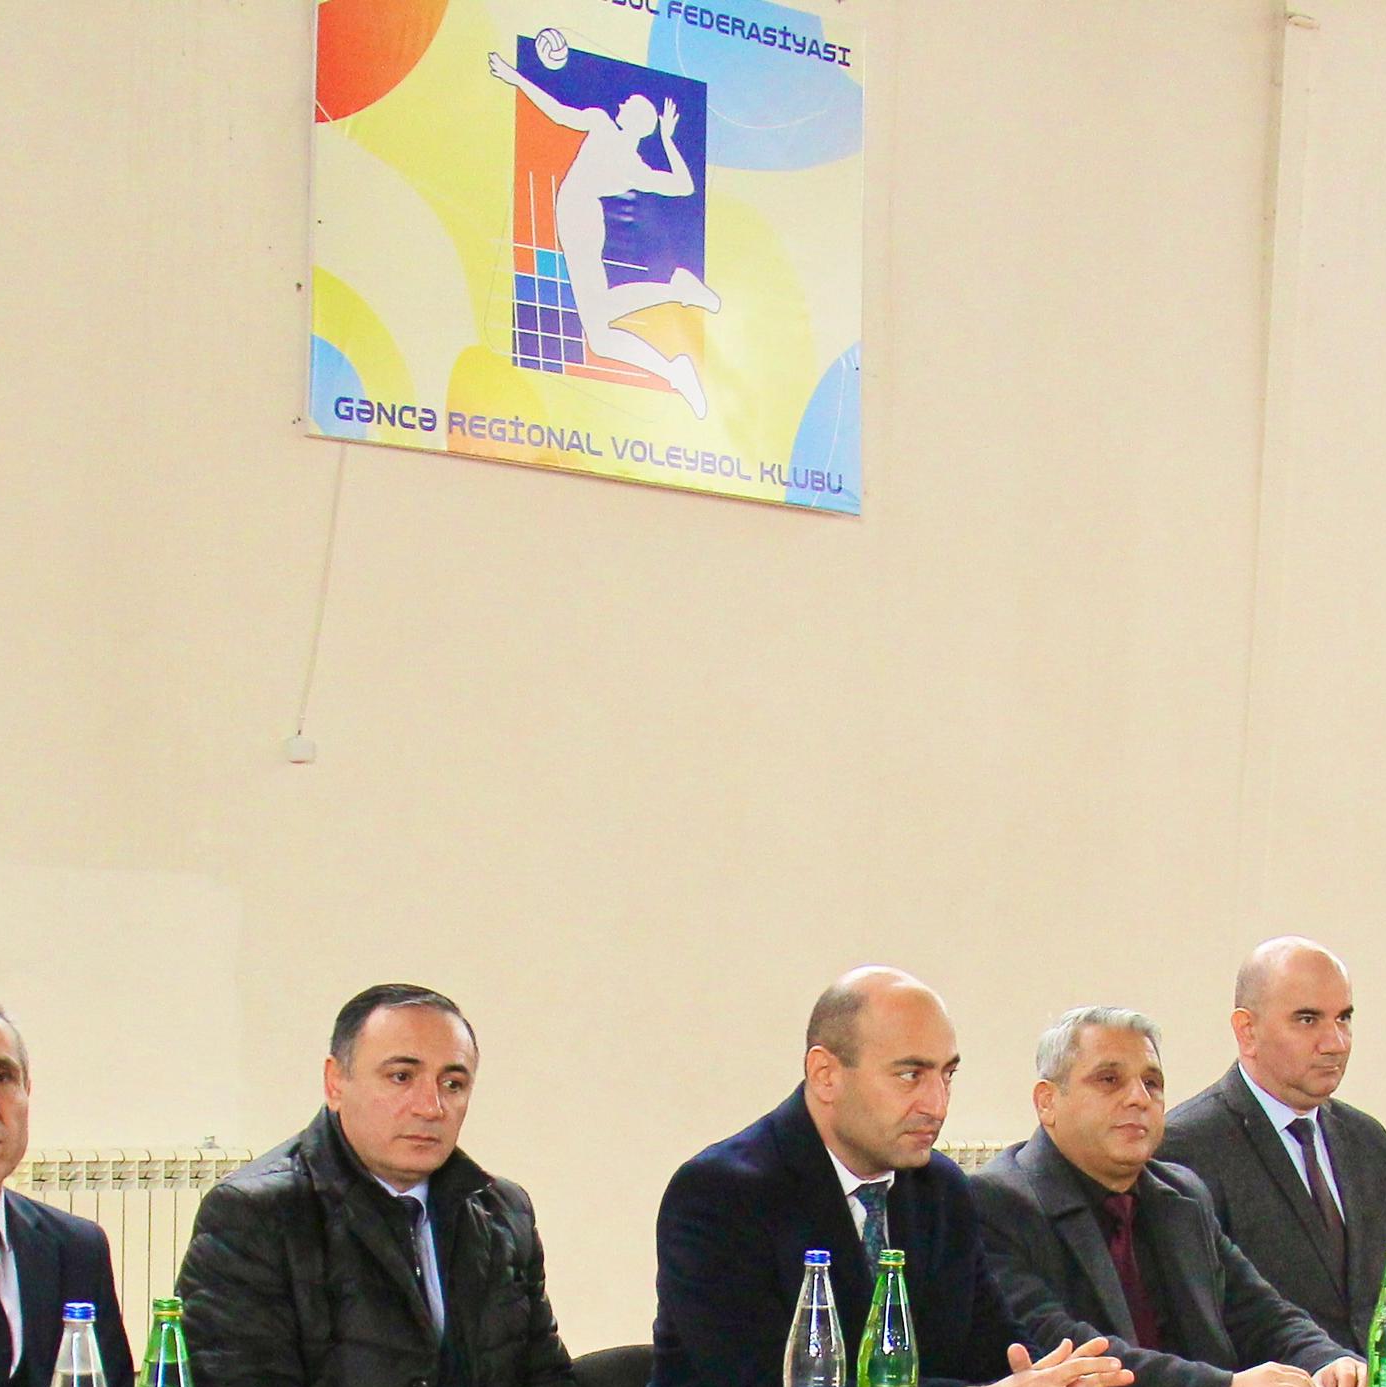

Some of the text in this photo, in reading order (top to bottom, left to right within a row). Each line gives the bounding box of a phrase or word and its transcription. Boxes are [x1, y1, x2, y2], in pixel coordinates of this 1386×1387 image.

[667, 2, 851, 67] FEDERASİYASI
[333, 396, 843, 494] GƏNCƏ REGİONAL VOLEYBOL KLUBU
